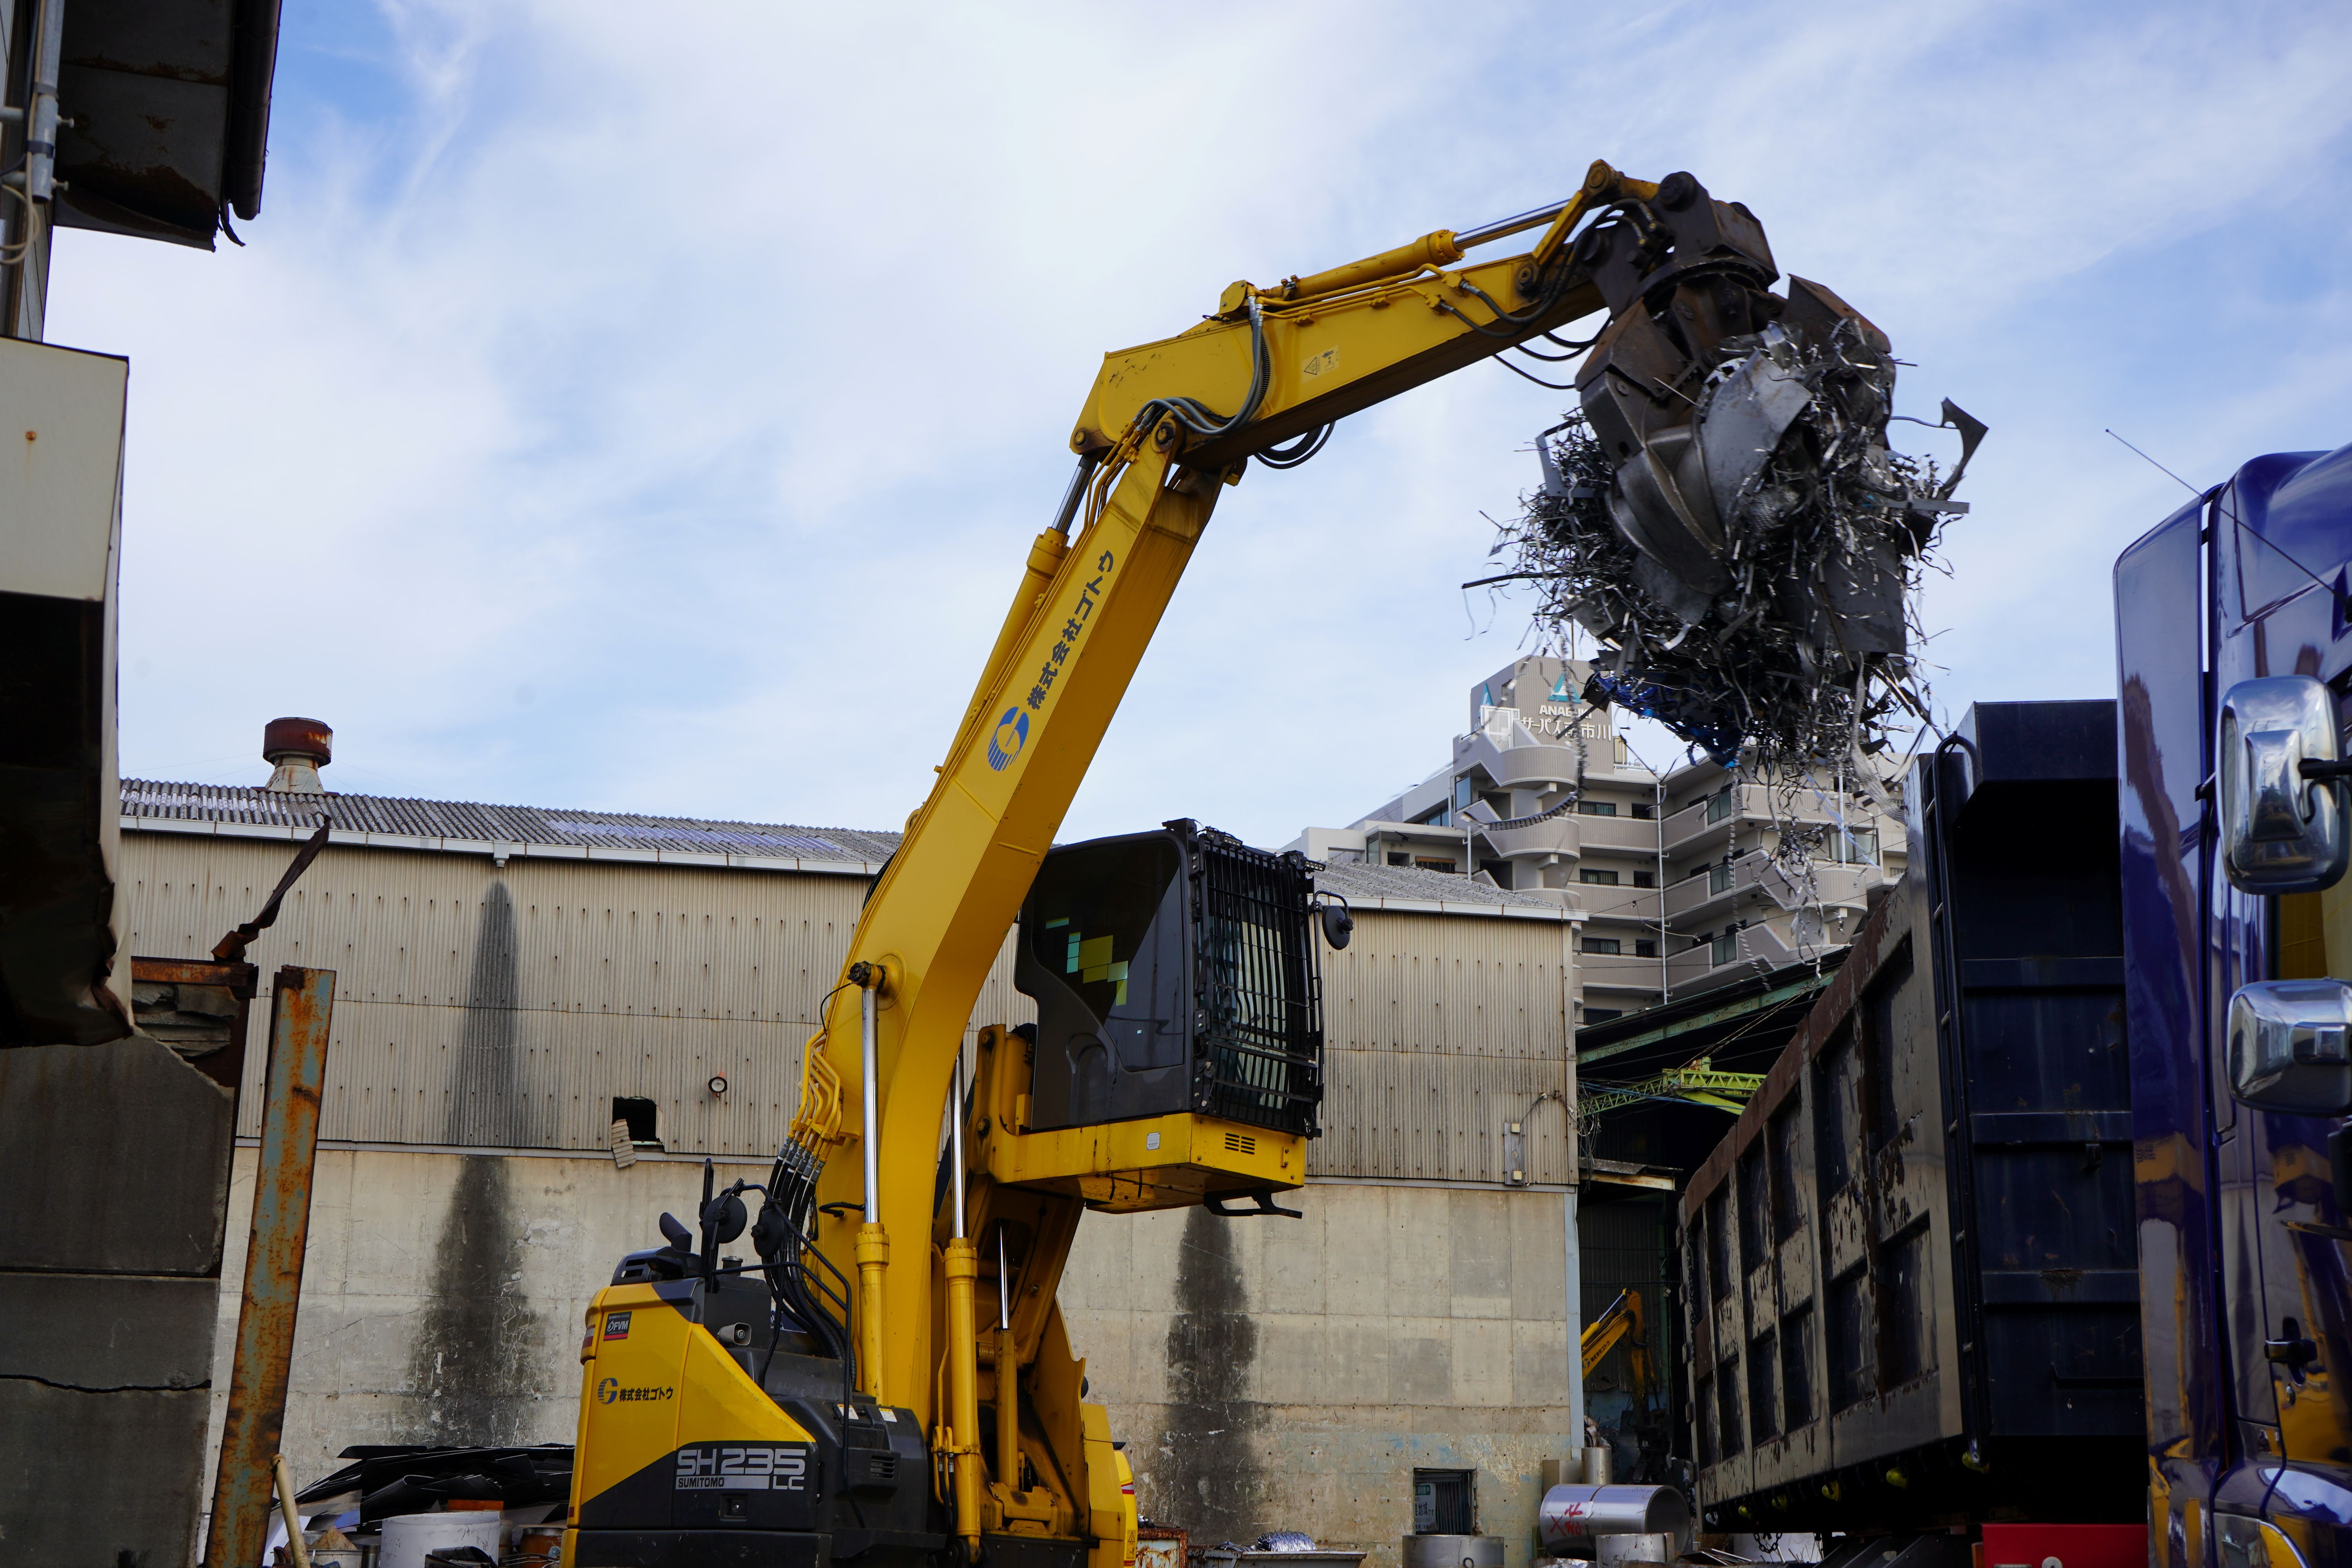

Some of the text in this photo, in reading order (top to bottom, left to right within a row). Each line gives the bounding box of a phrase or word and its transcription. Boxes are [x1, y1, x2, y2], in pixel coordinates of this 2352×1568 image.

[1027, 550, 1114, 710] 株式会社ゴトウ
[619, 1387, 673, 1402] 株式会社ゴトウ
[678, 1477, 725, 1488] SUMITOMO
[773, 1476, 805, 1490] LC
